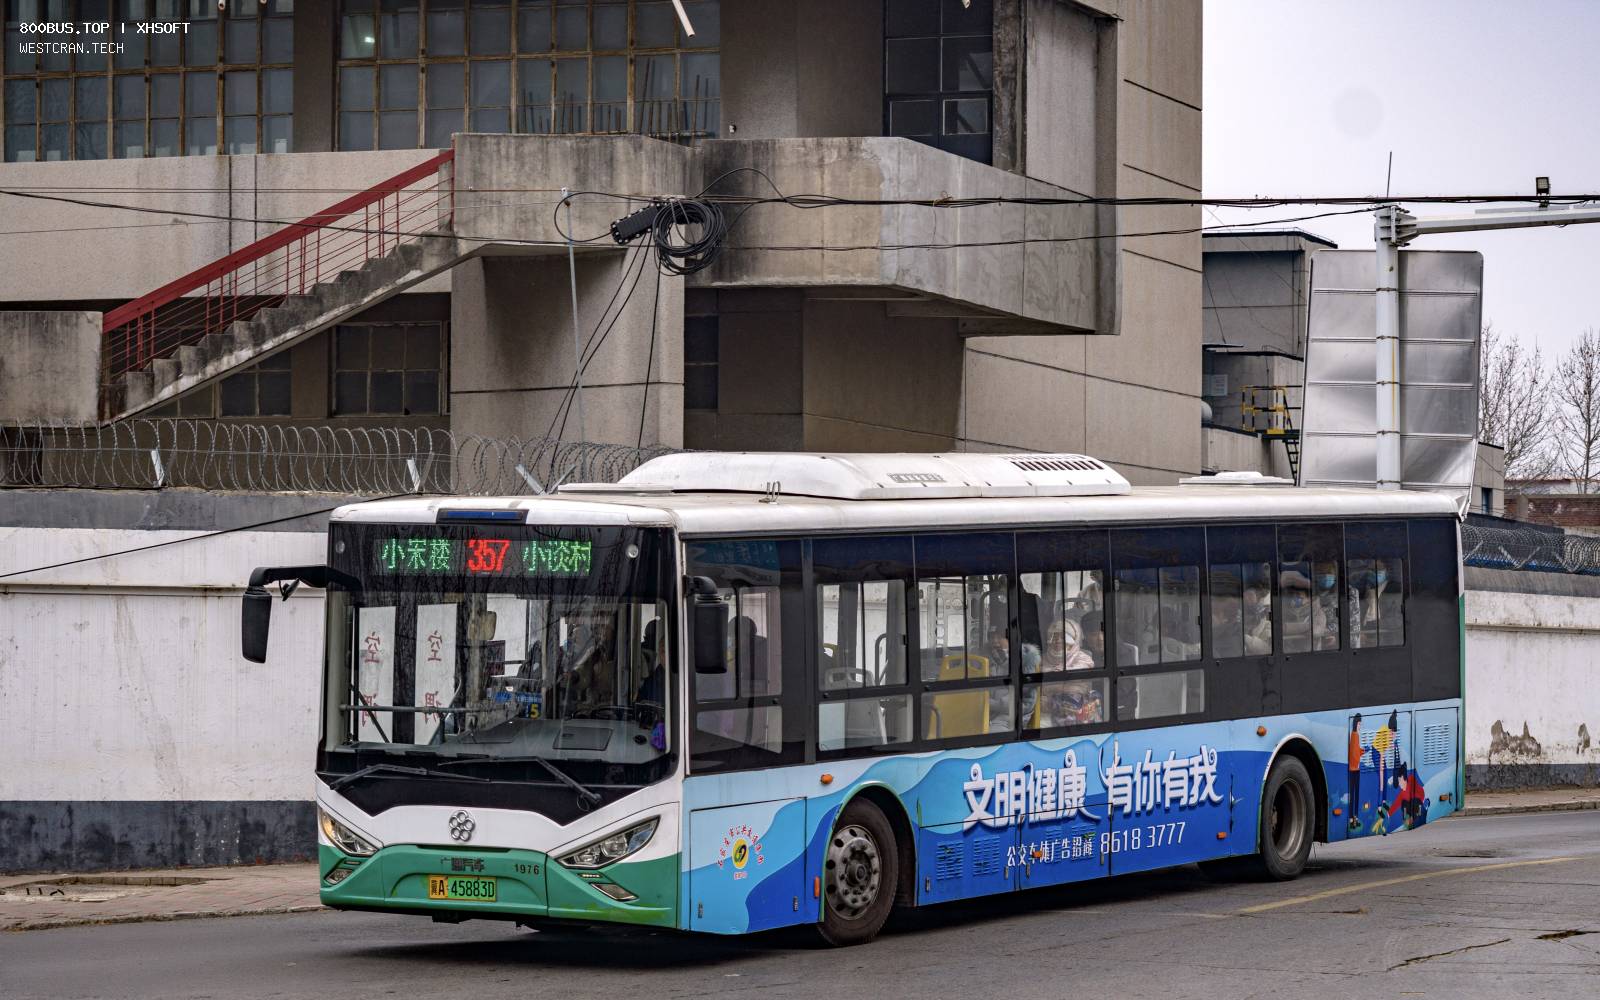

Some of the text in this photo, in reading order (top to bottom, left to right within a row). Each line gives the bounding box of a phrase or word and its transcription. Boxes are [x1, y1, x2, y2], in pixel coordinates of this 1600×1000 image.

[467, 538, 511, 572] 357
[523, 540, 592, 573] 小谈村
[963, 736, 1224, 830] 文明健康 有你有我
[1100, 828, 1142, 855] 8618
[1147, 821, 1186, 849] 3777
[514, 863, 541, 876] 1976
[451, 880, 495, 898] 45883D
